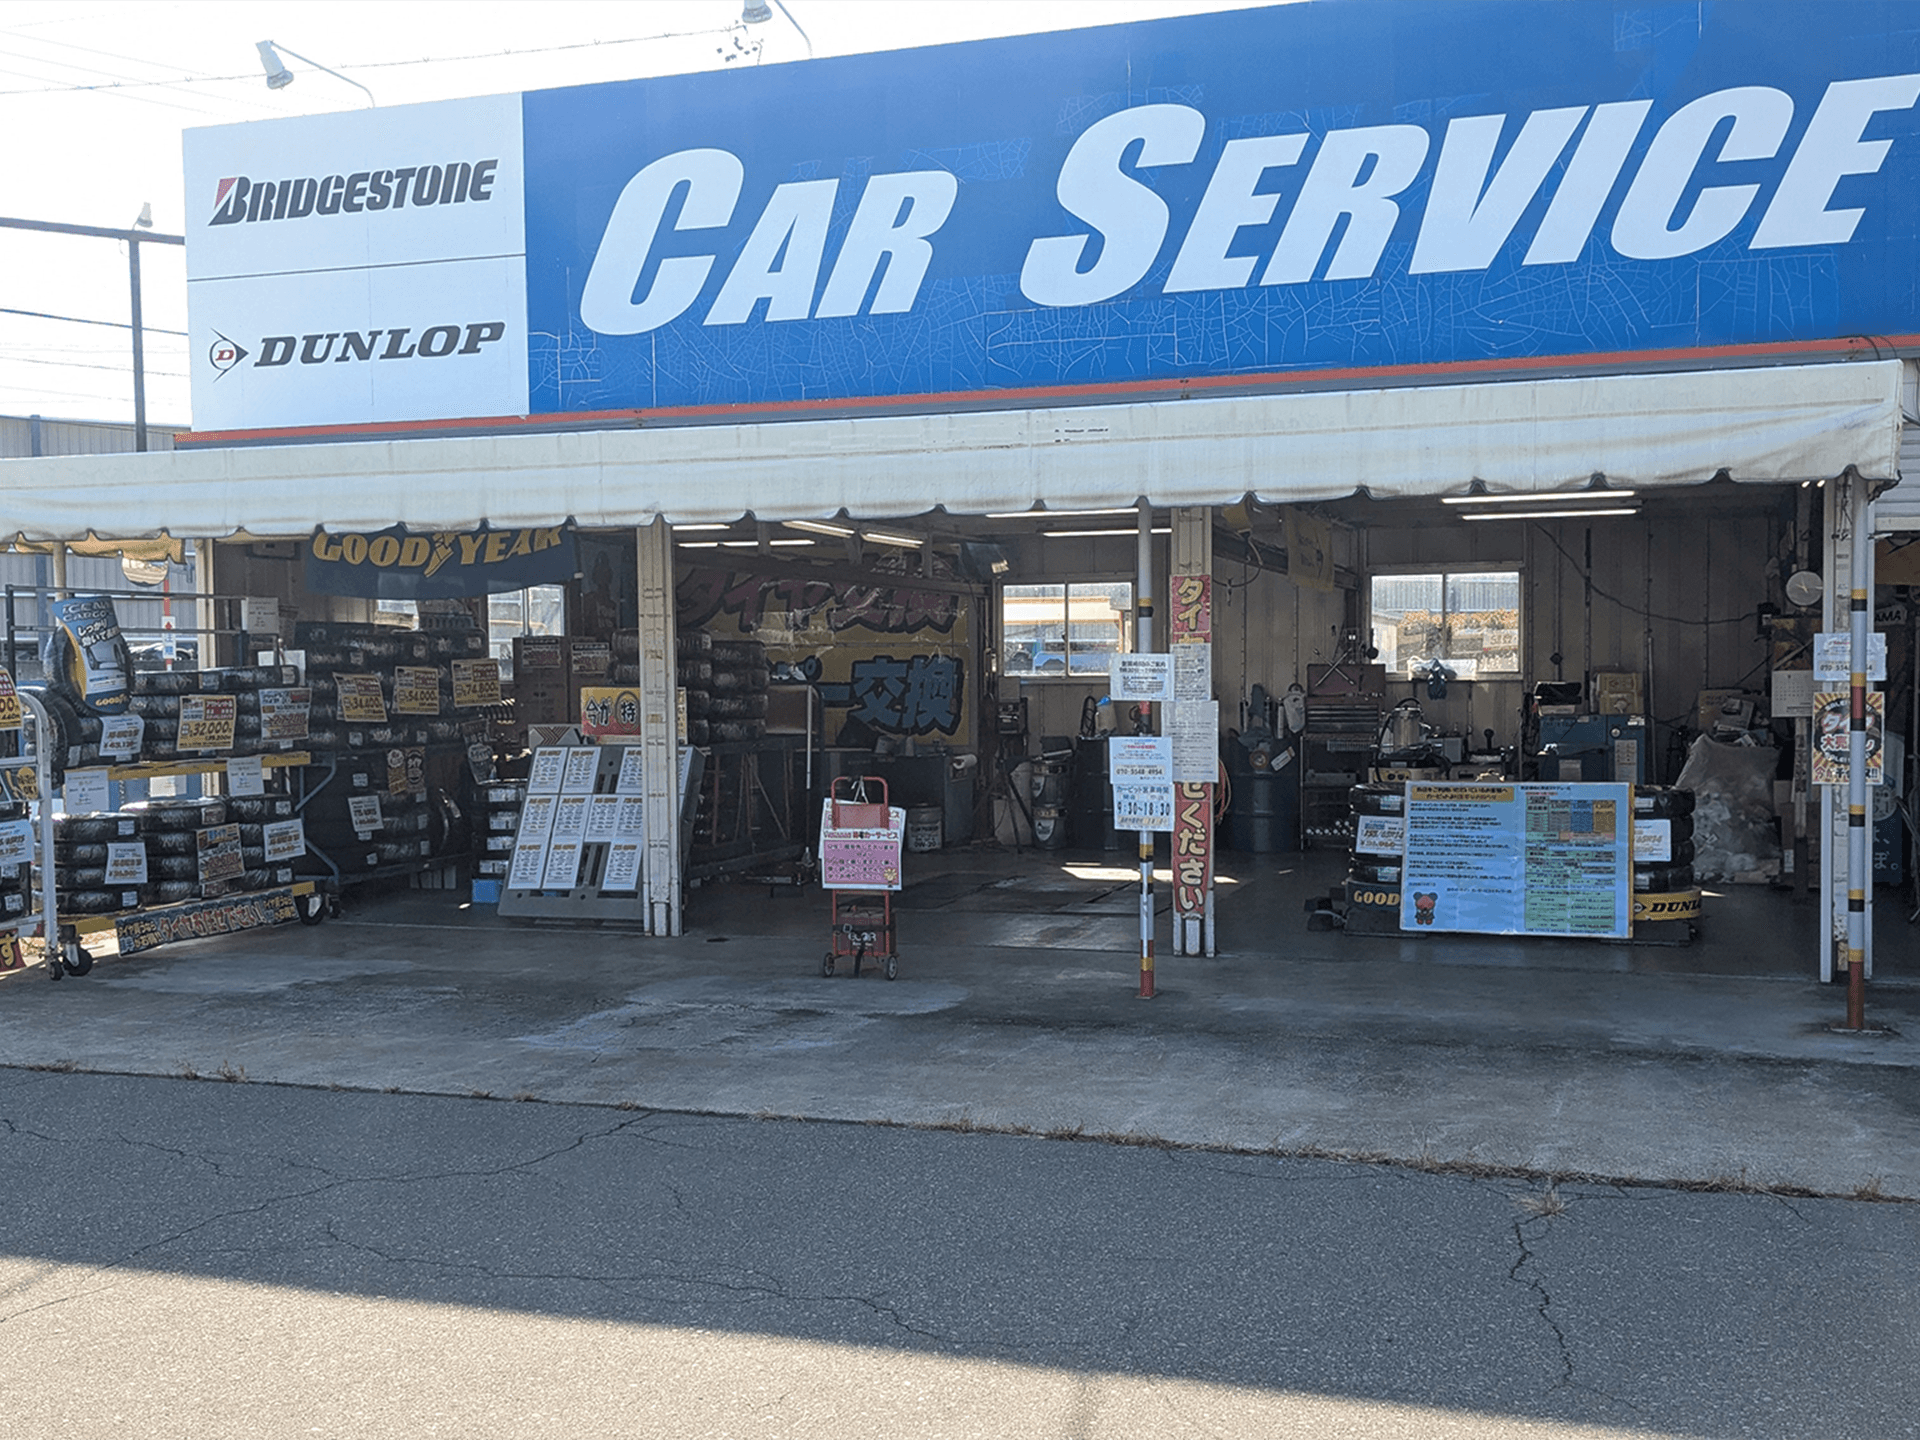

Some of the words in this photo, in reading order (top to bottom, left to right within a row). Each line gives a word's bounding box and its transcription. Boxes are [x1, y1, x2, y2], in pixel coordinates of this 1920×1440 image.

[208, 159, 498, 226] BRIDGESTONE
[580, 148, 957, 335] CAR
[1020, 74, 1920, 307] SERVICE
[253, 321, 505, 368] DUNLOP
[1178, 577, 1205, 643] タイ
[1354, 890, 1401, 906] GOOD
